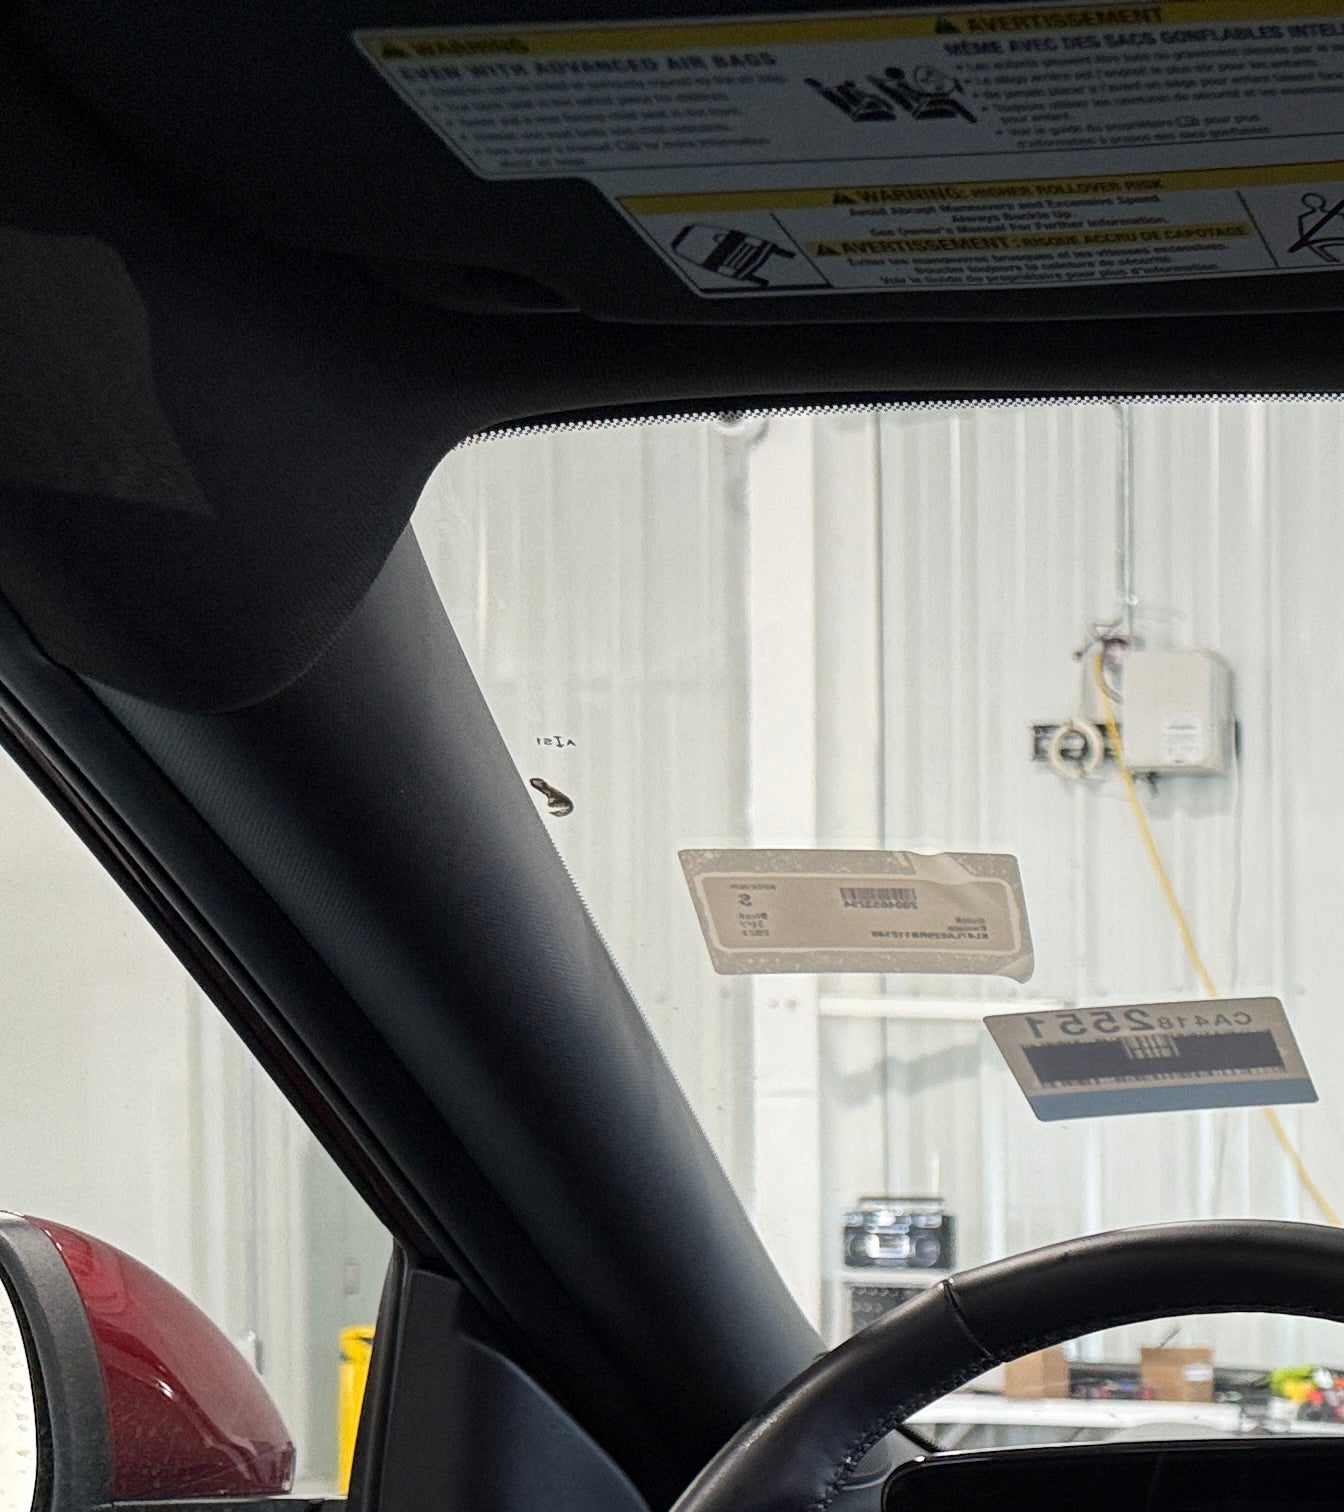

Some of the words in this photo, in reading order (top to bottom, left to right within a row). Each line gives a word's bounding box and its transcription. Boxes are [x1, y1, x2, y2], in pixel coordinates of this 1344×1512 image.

[967, 7, 1162, 32] AVERTISSEMENT
[1009, 37, 1059, 53] AVEC
[1063, 34, 1101, 49] DES
[1104, 31, 1156, 47] SACS
[1160, 25, 1283, 44] GONFLABLES
[400, 64, 460, 80] EVEN
[463, 62, 525, 78] WITH
[534, 58, 658, 75] ADVANCED
[667, 55, 706, 71] AIR
[712, 52, 777, 69] BAGS
[970, 184, 1032, 198] HIGHER
[1036, 181, 1122, 195] ROLLOVER
[1164, 226, 1248, 239] CAPOTAGE
